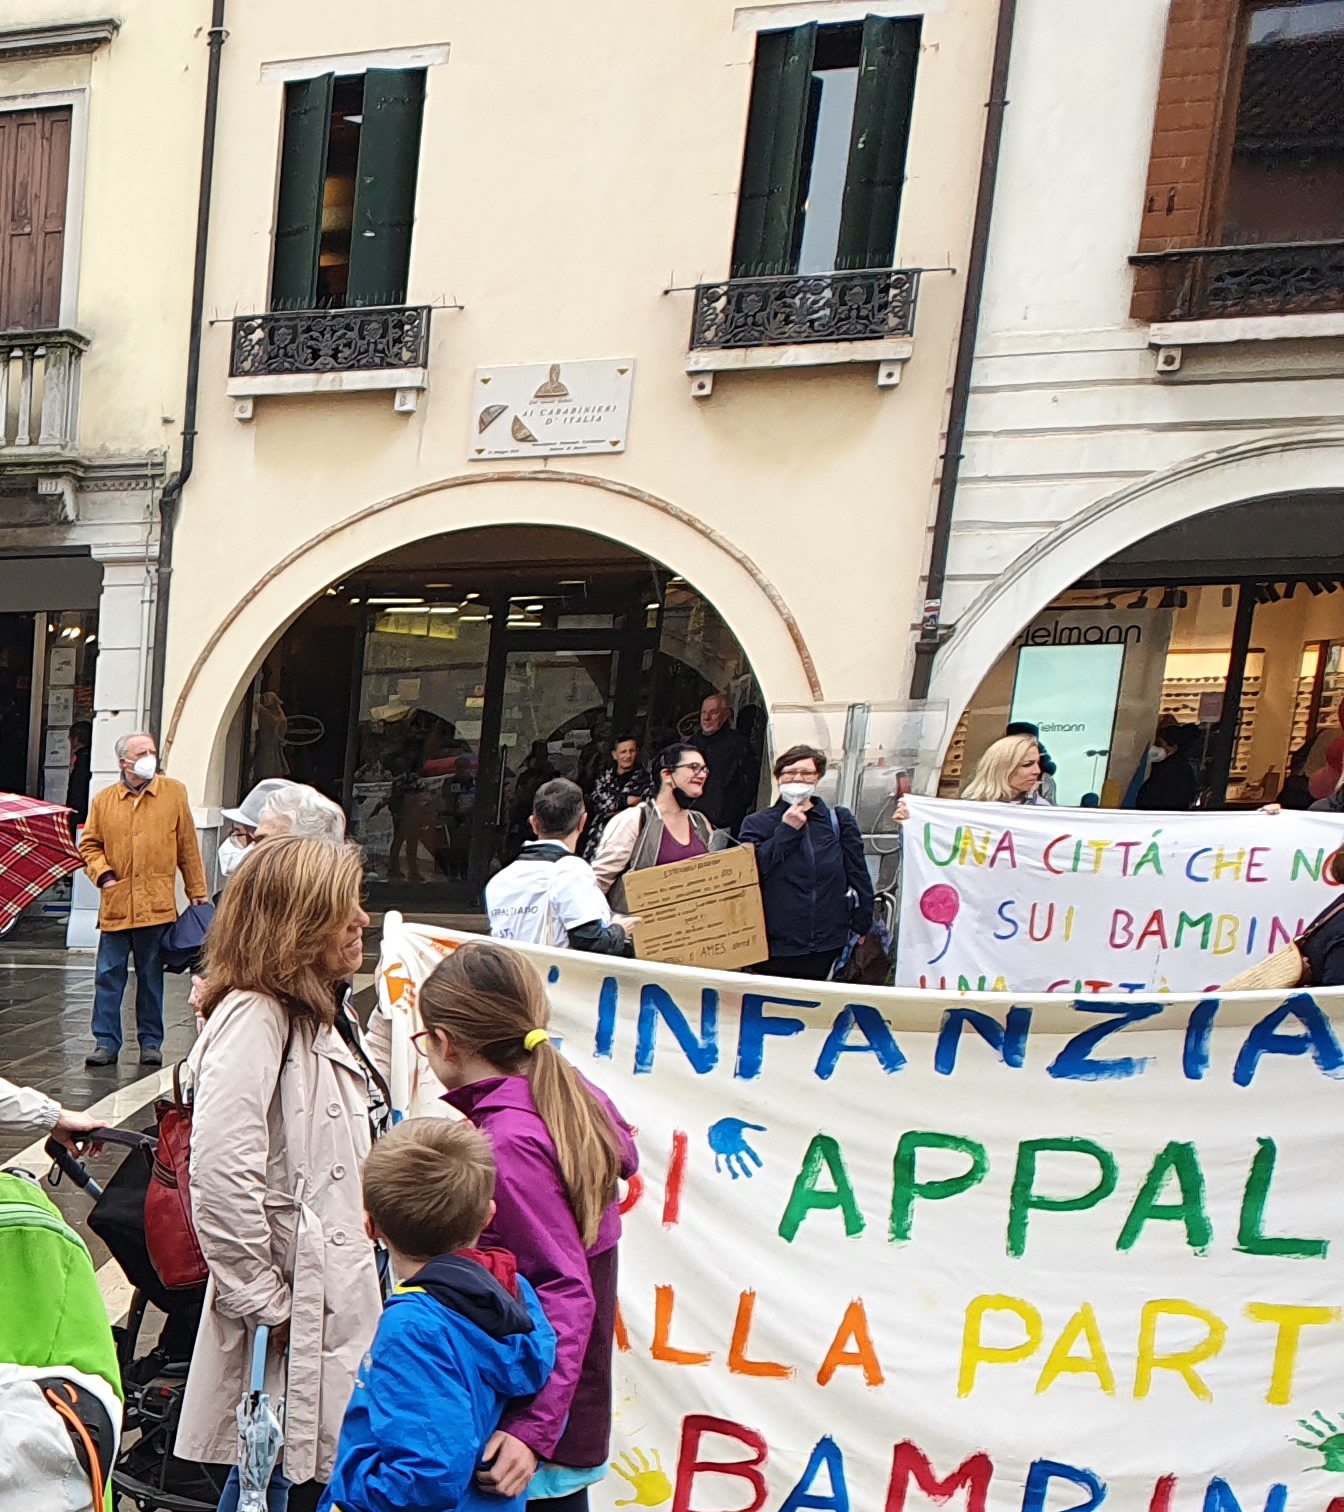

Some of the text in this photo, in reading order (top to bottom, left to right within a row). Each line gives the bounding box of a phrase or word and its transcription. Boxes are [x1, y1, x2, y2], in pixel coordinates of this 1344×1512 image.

[563, 415, 602, 425] ITALIA
[923, 822, 1017, 869] UNA
[1185, 846, 1272, 883] CHE
[992, 900, 1075, 944] SUI
[547, 965, 1344, 1088] 'INFANZIA
[777, 1129, 1331, 1259] APPAL
[614, 1283, 1342, 1407] LLA PART
